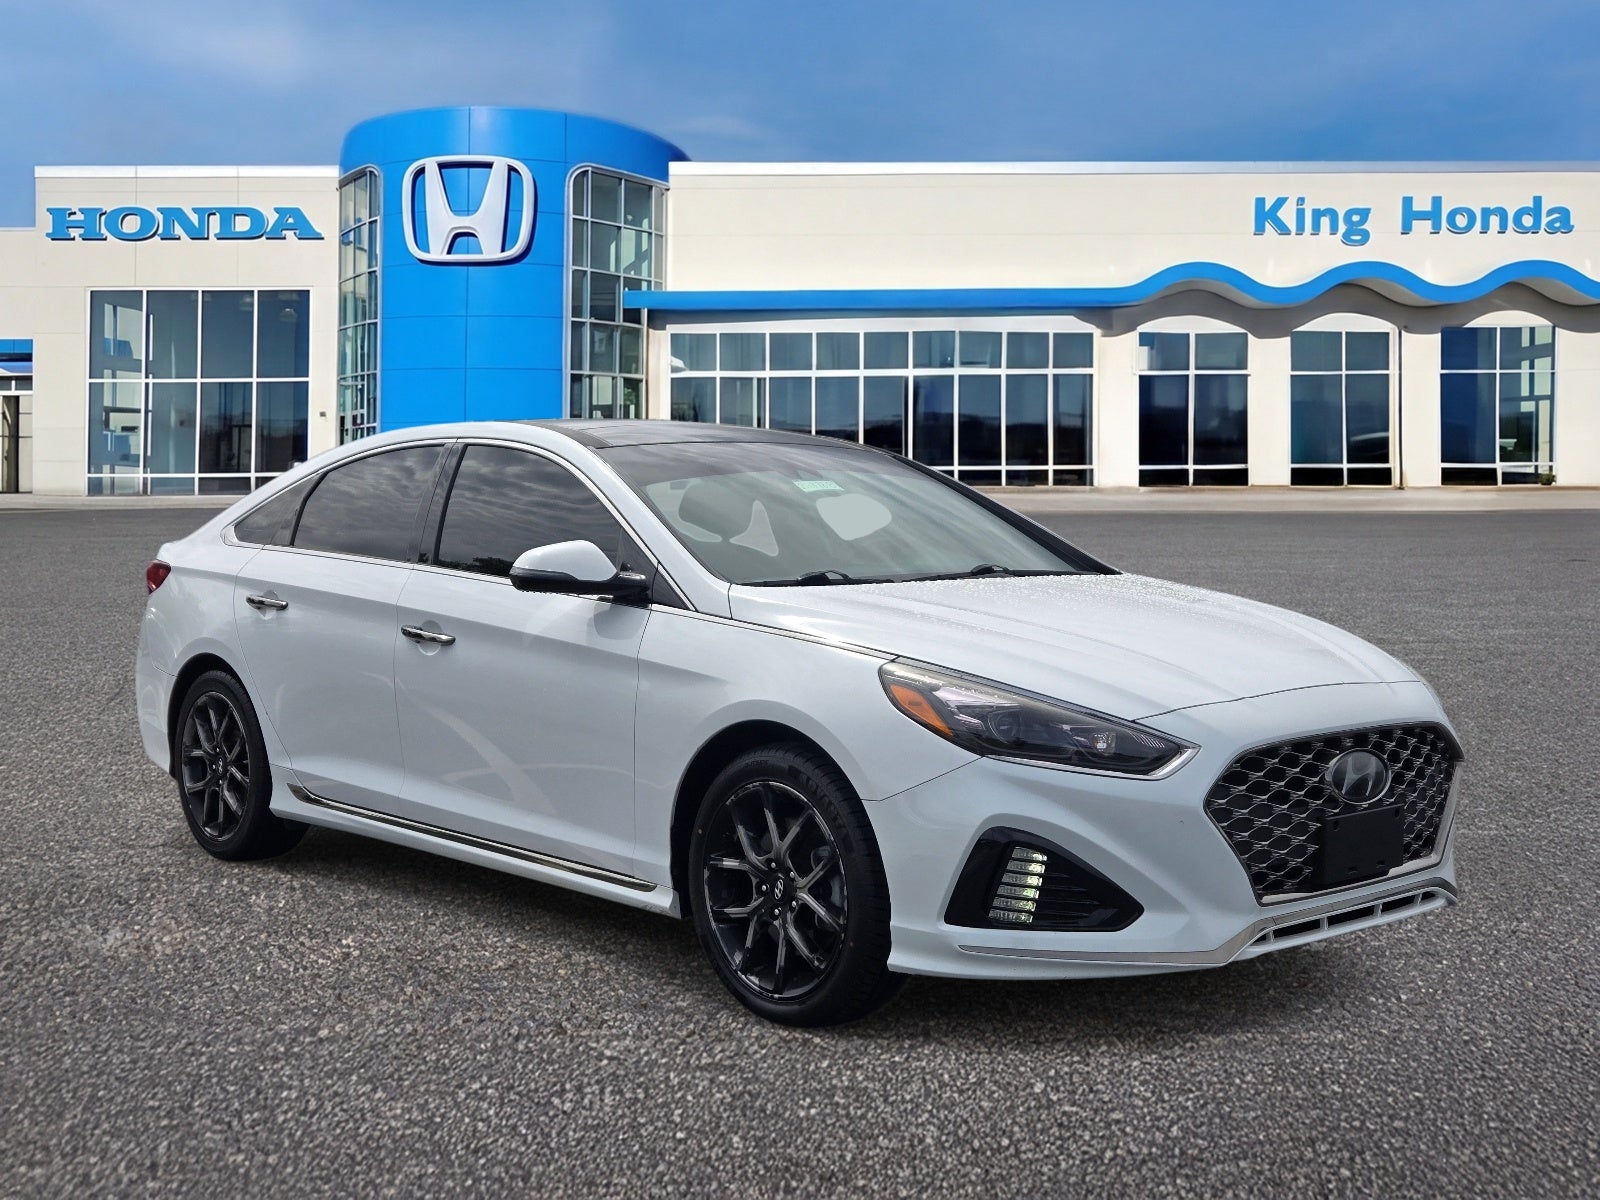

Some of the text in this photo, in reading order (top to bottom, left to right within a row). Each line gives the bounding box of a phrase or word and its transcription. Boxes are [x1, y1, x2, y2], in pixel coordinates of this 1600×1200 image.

[45, 206, 324, 241] HONDA
[1253, 195, 1575, 246] King Honda
